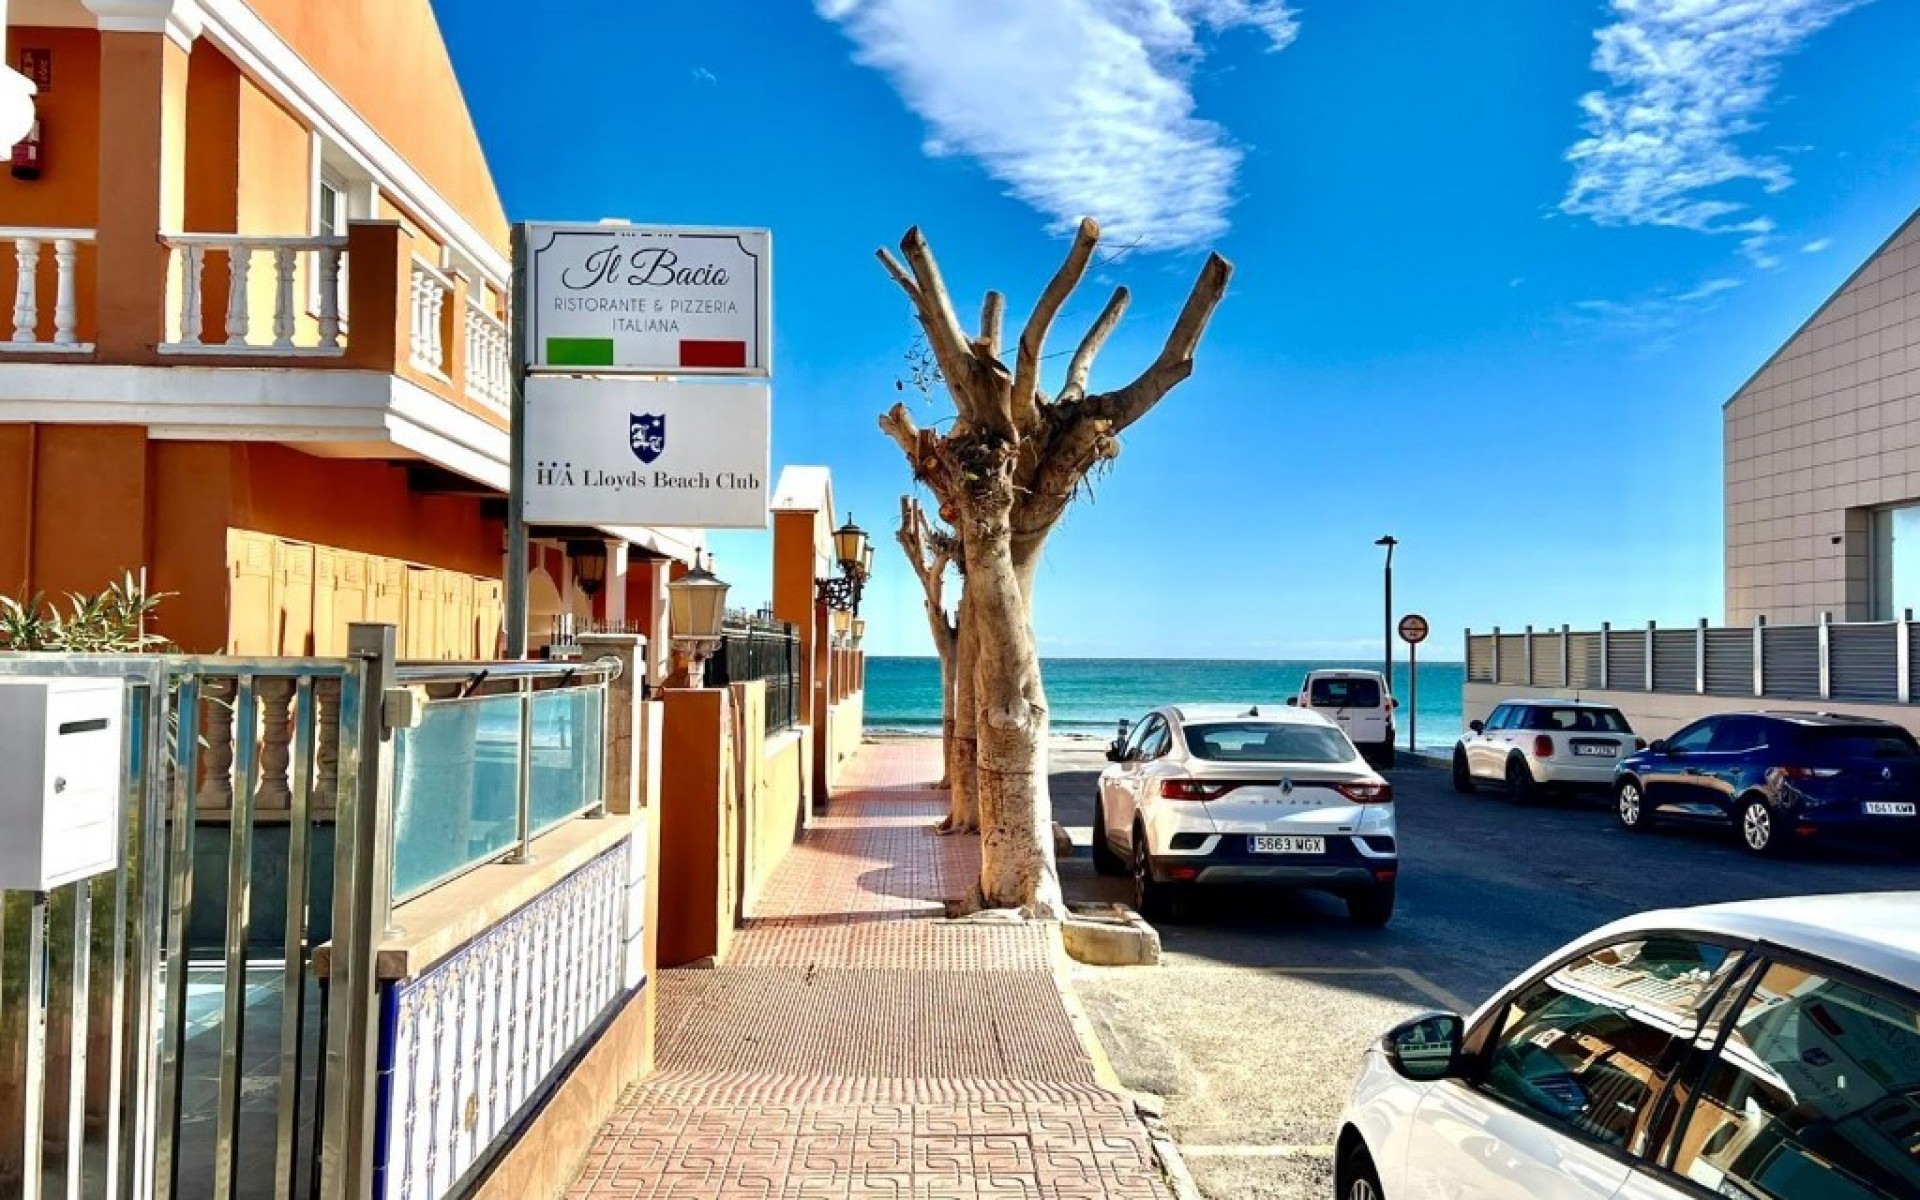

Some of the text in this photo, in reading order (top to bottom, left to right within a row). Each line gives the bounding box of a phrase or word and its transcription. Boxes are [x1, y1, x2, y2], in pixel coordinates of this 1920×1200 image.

[562, 245, 729, 290] Il Bacio
[554, 298, 738, 314] RISTORANTE & PIZZERIA
[613, 318, 680, 332] ITALIANA
[584, 470, 646, 492] Lloyds
[653, 471, 710, 488] Beach
[716, 472, 760, 489] Club
[1257, 837, 1291, 850] 5663
